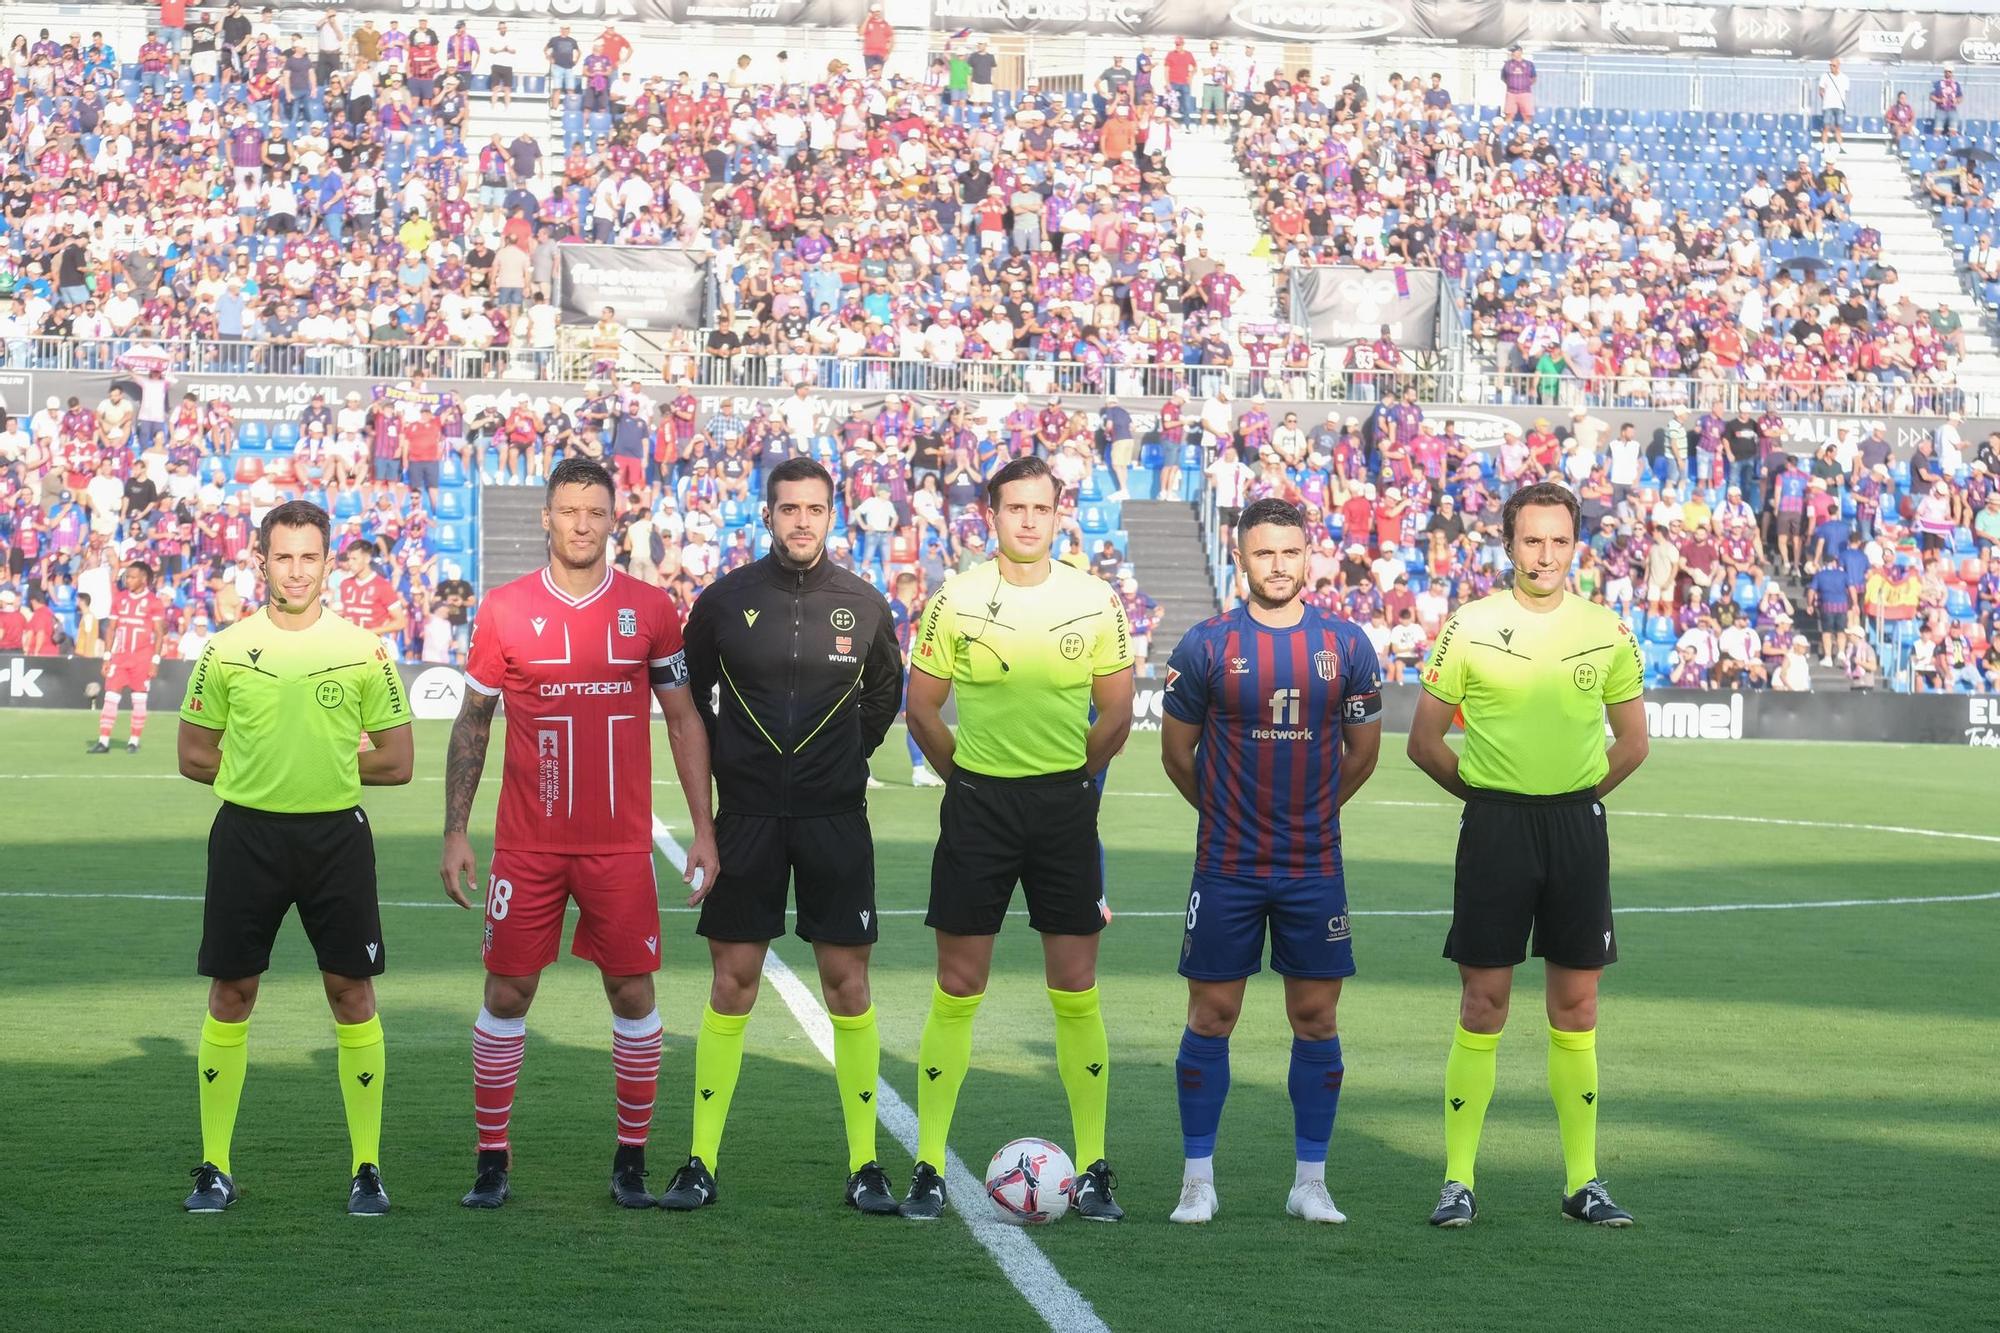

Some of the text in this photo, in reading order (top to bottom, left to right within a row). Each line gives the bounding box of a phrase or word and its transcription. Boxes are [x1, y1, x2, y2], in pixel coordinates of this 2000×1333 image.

[1600, 4, 1716, 34] PALLEX
[186, 383, 250, 403] FIBRA
[254, 385, 272, 403] Y
[925, 595, 948, 642] WÜRTH
[1434, 620, 1459, 667] WÜRTH
[194, 646, 216, 696] WÜRTH
[382, 662, 402, 714] WÜRTH
[671, 660, 688, 680] VS
[1269, 688, 1300, 725] fi
[1252, 727, 1313, 741] network
[486, 873, 513, 921] 18
[1187, 890, 1201, 930] 8
